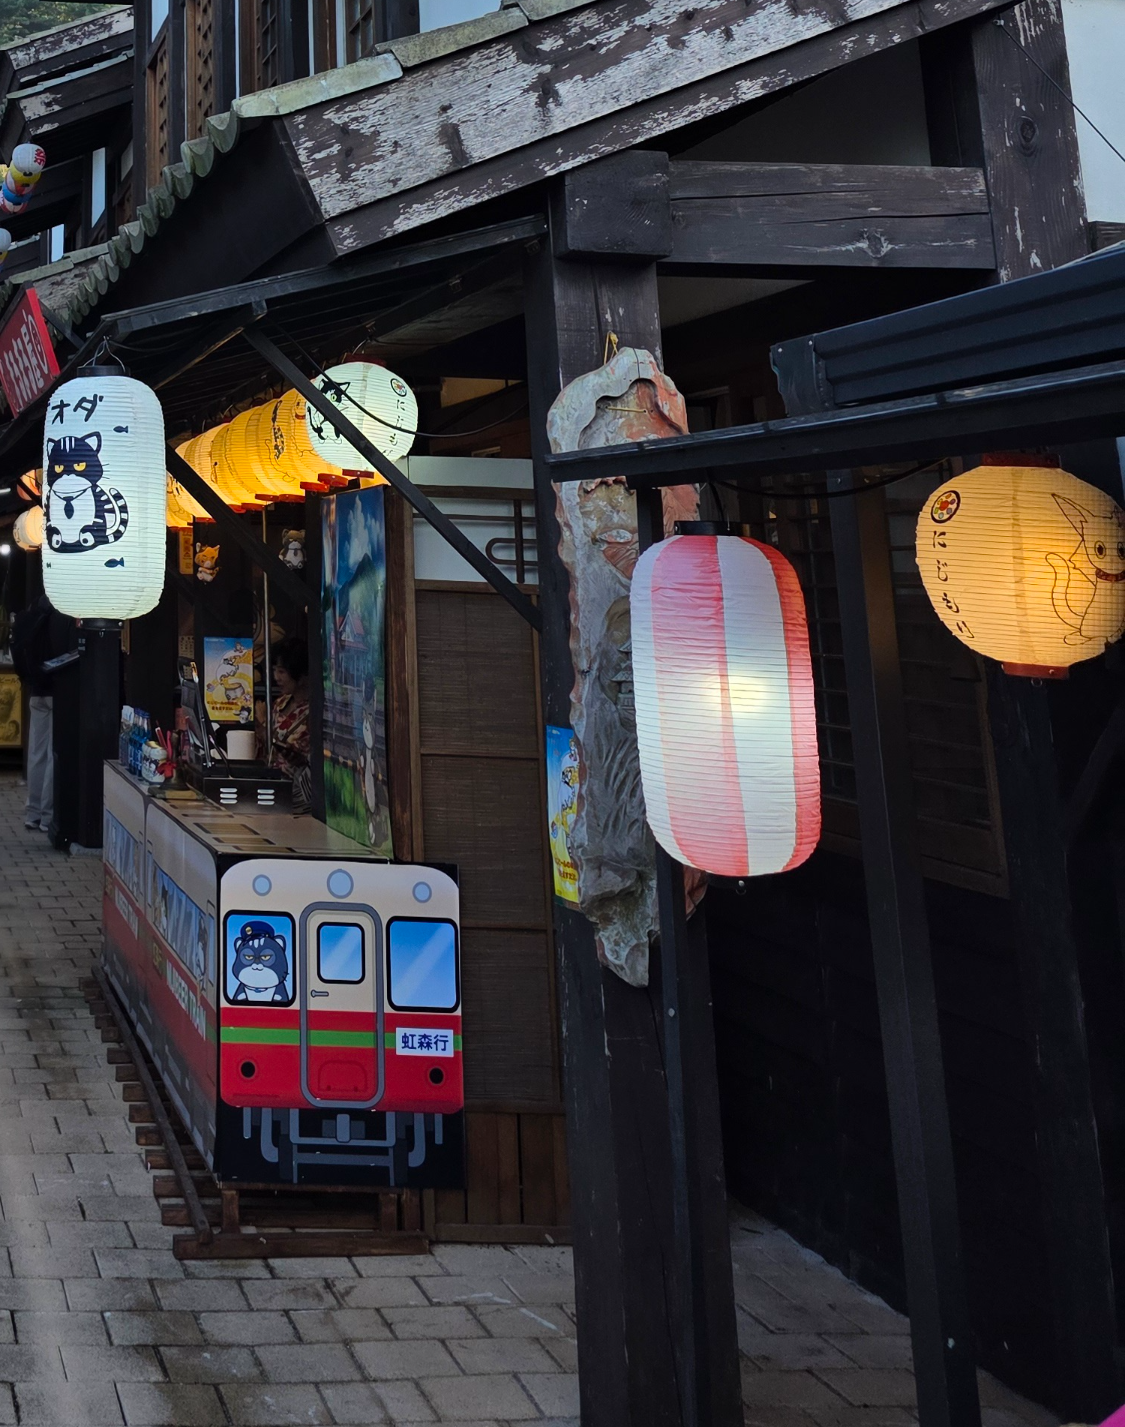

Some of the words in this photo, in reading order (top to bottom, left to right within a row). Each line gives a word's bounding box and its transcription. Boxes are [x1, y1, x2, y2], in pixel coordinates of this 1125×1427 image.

[932, 530, 975, 639] にじもり
[401, 1032, 449, 1051] 虹森行
